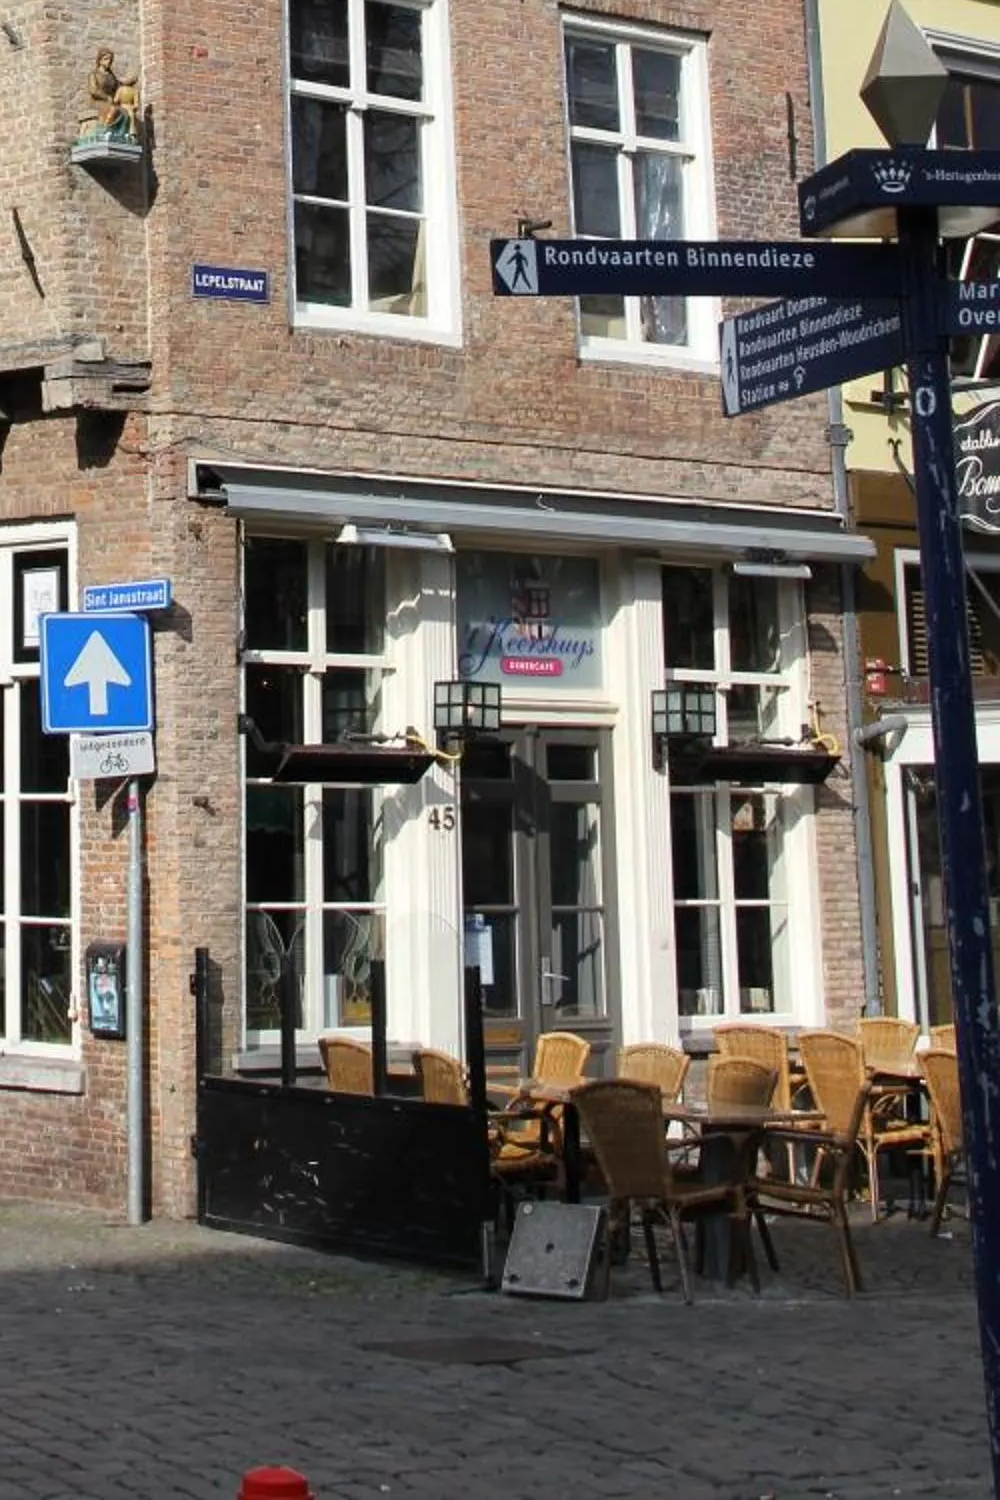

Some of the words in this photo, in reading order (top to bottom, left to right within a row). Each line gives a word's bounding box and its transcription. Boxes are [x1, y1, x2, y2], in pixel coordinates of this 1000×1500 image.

[545, 245, 679, 267] Rondvaarten
[687, 247, 816, 268] Binnendieze
[195, 273, 265, 292] LEPELSTRAAT
[959, 283, 999, 300] Mar
[739, 327, 798, 355] Rondvaarten
[801, 303, 863, 337] Binnendieze
[741, 383, 775, 406] Station
[87, 592, 107, 607] Sint
[109, 587, 163, 607] Jansstraat
[80, 736, 146, 753] uitgezonderd
[428, 806, 456, 831] 45
